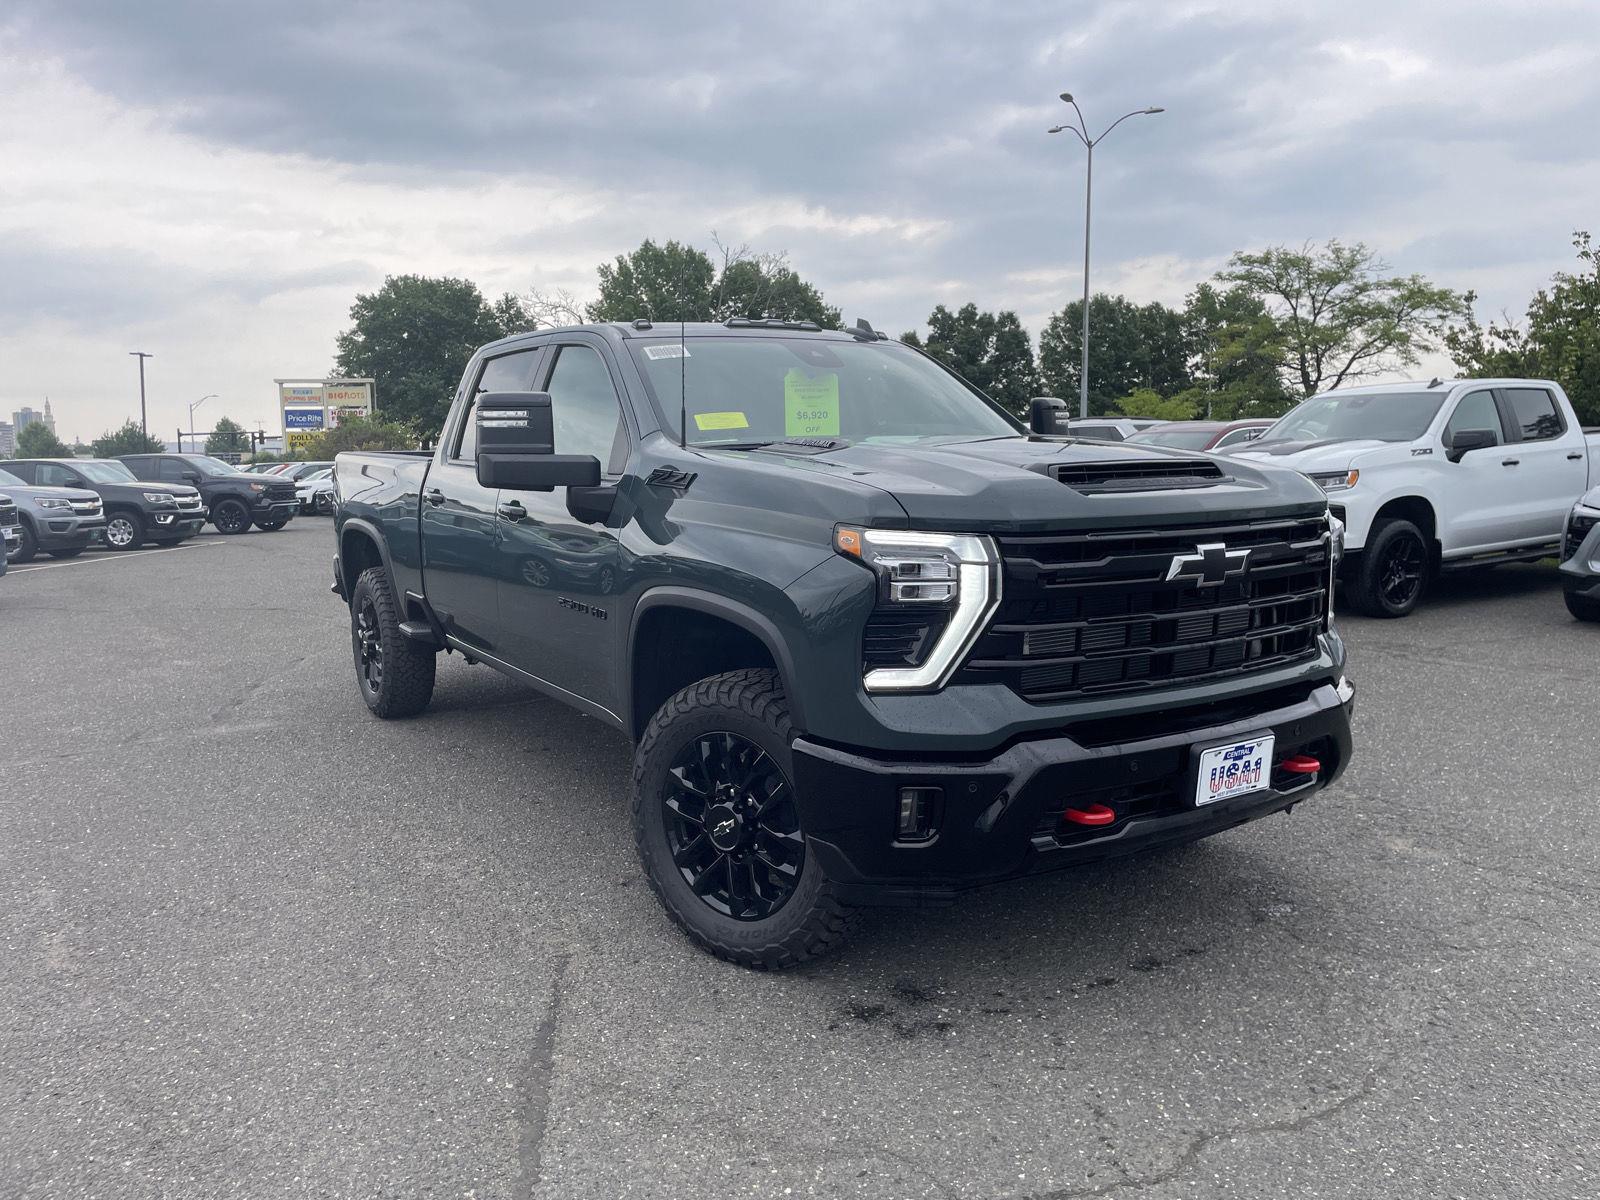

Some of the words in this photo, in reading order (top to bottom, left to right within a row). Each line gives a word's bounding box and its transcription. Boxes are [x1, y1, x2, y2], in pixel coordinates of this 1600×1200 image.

[287, 414, 307, 422] Price
[307, 414, 322, 422] Rite
[797, 410, 828, 421] $6,920
[1226, 748, 1251, 759] CENTRAL
